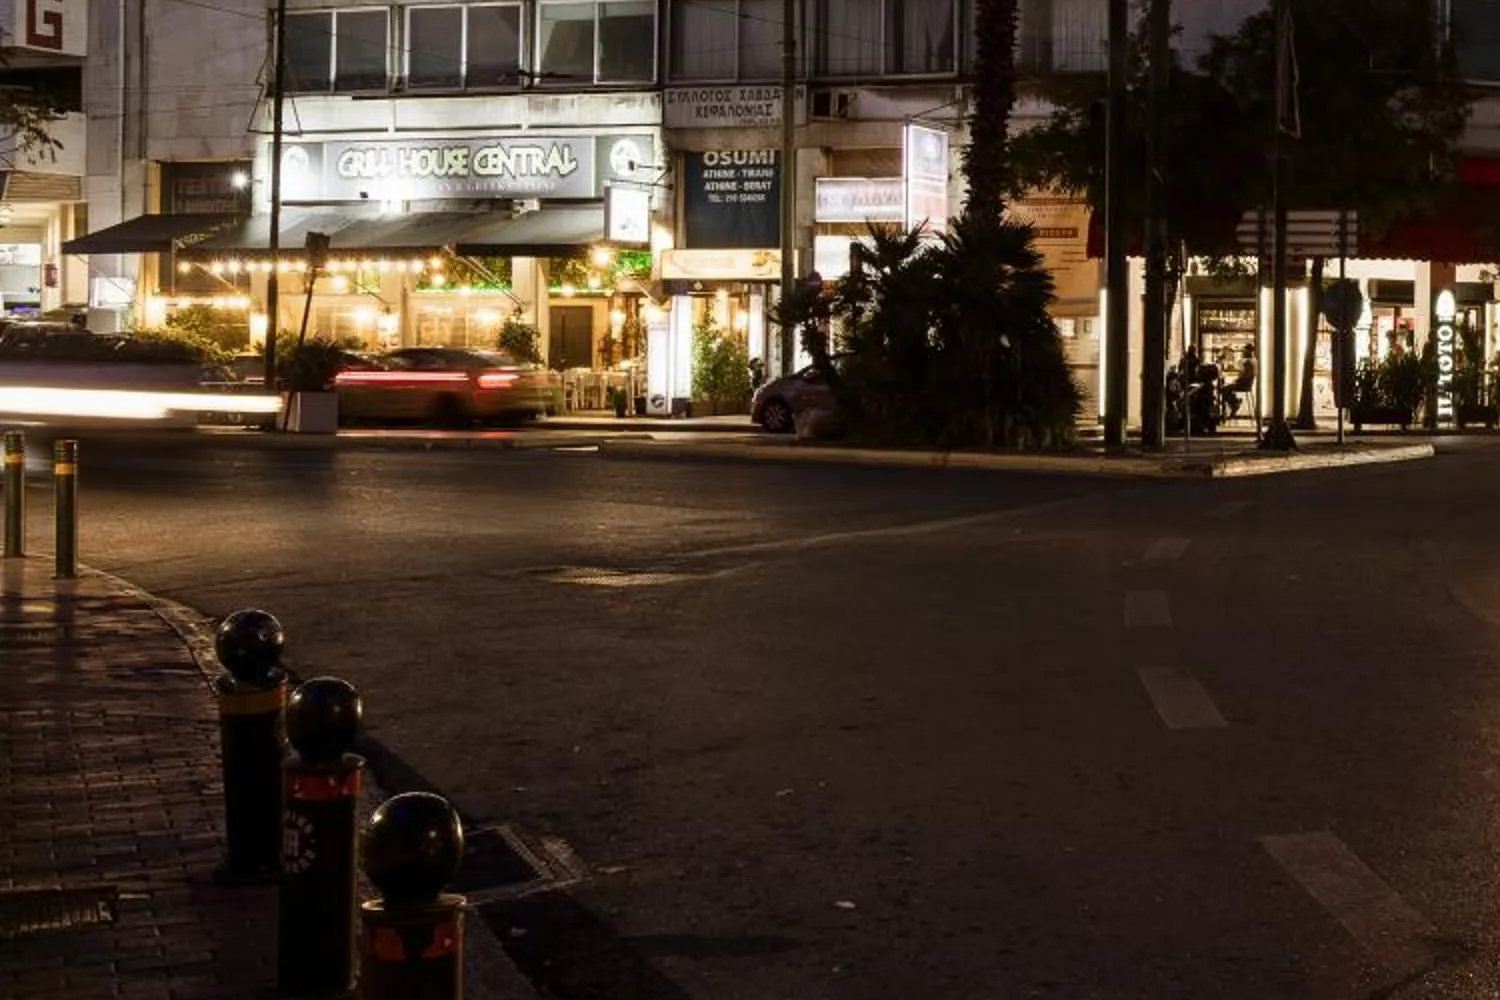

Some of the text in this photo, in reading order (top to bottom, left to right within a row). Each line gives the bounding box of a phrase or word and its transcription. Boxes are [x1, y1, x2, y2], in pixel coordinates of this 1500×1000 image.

[399, 146, 470, 178] HOUSE
[473, 142, 579, 180] CENTRAL
[703, 149, 775, 166] OSUMI
